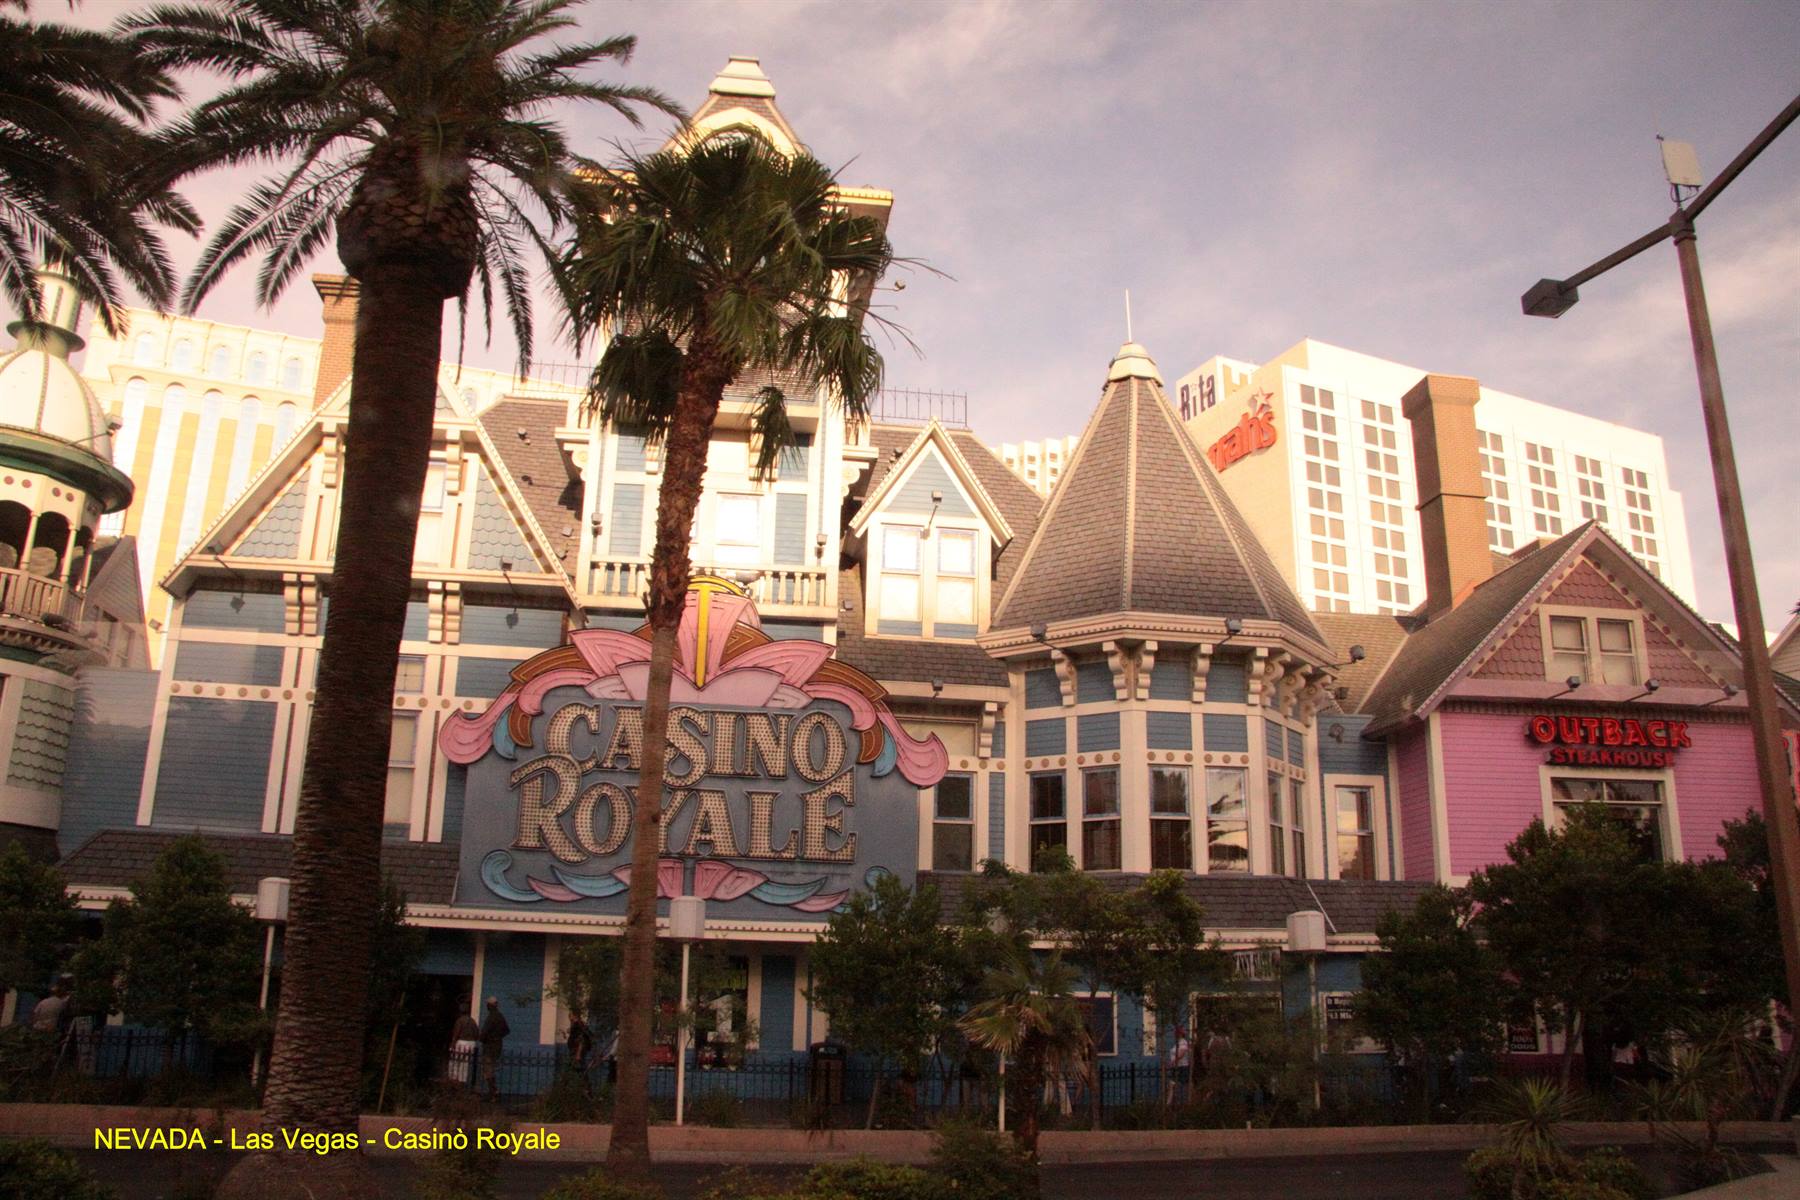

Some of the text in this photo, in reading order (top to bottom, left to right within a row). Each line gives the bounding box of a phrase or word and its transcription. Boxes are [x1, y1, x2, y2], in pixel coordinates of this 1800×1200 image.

[1179, 374, 1216, 421] Rita
[545, 702, 848, 788] CASINO
[1532, 715, 1692, 748] OUTBACK
[1553, 748, 1675, 767] STEAKHOUSE
[510, 754, 857, 863] ROYALE
